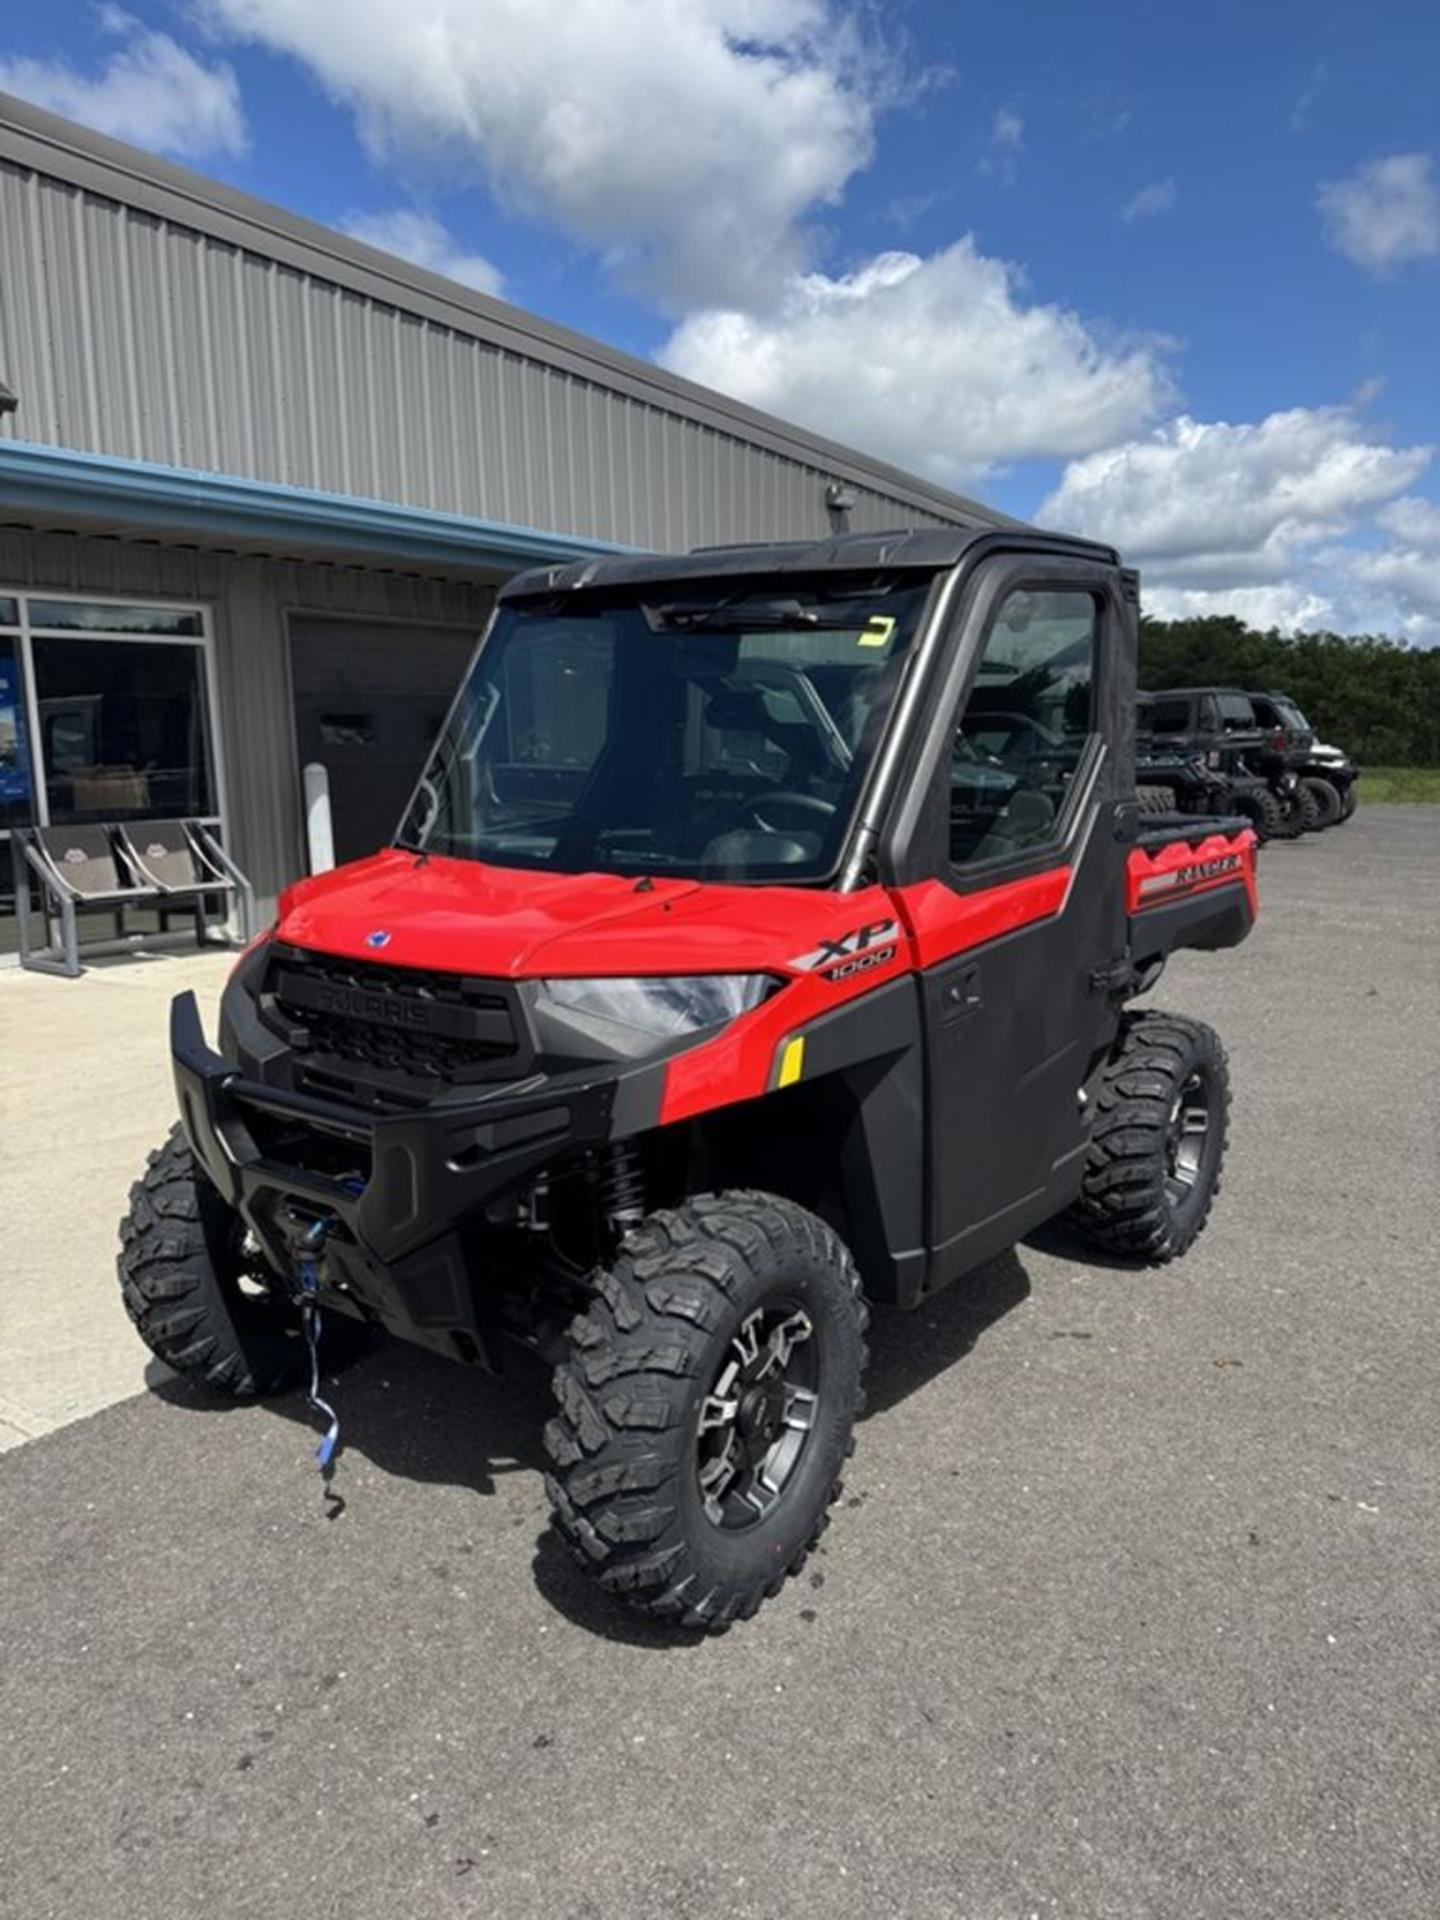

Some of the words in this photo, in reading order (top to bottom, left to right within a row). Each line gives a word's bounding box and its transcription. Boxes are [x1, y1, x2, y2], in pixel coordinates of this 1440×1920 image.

[1175, 855, 1237, 883] RANGER
[812, 918, 894, 967] XP
[831, 946, 893, 979] 1000
[319, 986, 428, 1024] POLARIS
